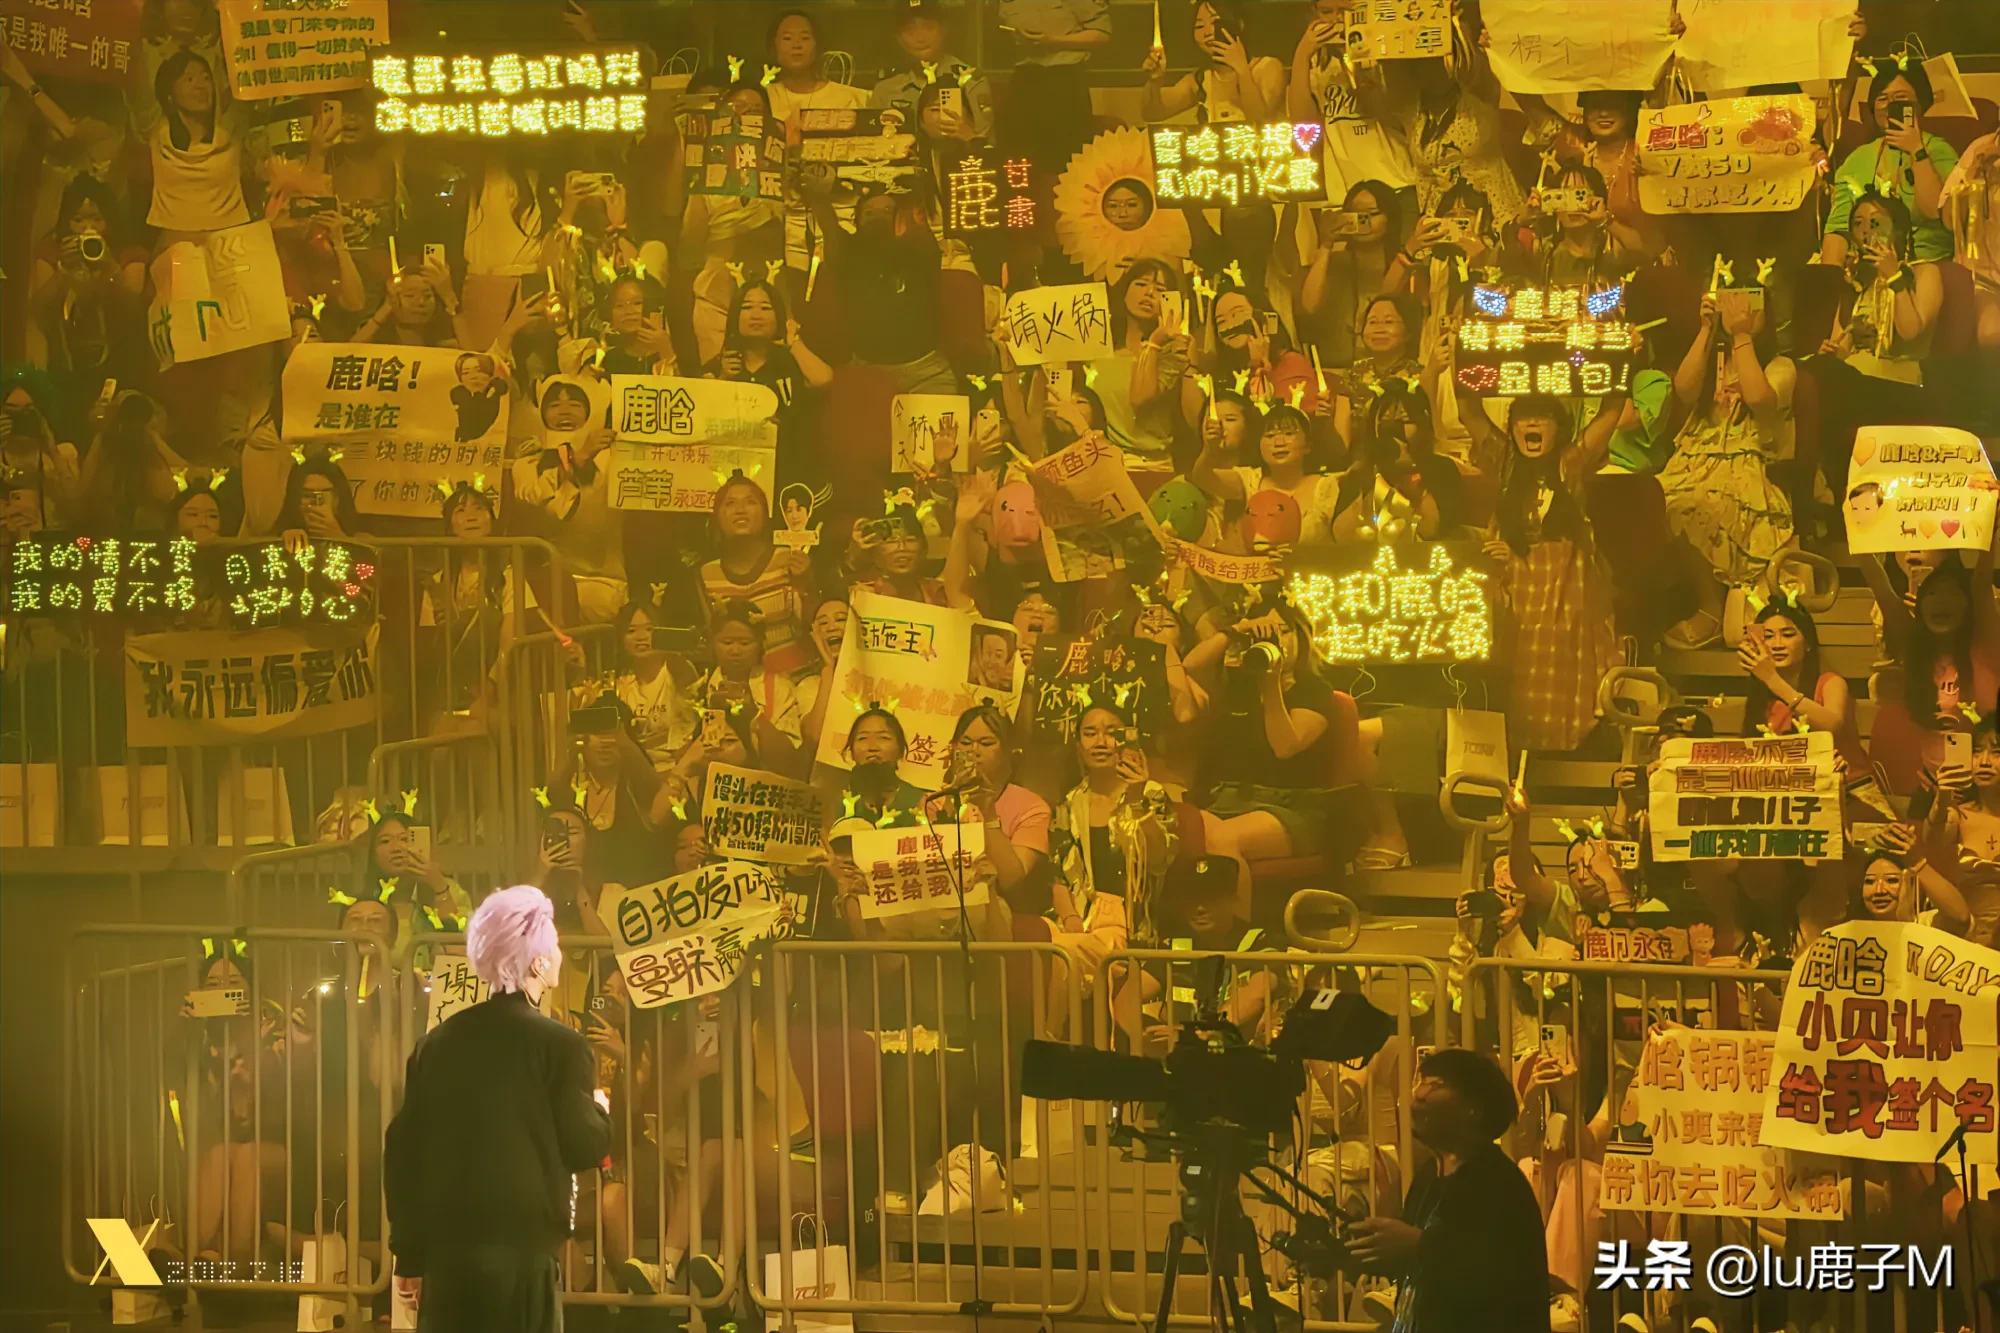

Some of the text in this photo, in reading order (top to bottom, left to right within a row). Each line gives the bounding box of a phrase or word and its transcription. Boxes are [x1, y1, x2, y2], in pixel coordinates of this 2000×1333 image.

[1006, 293, 1108, 355] 请火锅
[325, 354, 422, 392] 鹿晗！
[313, 402, 401, 430] 是谁在
[621, 384, 696, 436] 鹿晗
[11, 536, 197, 575] 我的情不变
[11, 574, 197, 613] 我的爱不移
[138, 640, 375, 720] 我永远偏爱你
[873, 873, 952, 907] 还给我
[1799, 932, 1888, 996] 鹿晗
[1796, 991, 1964, 1062] 小贝让你
[1776, 1058, 1995, 1140] 给我签个名
[1603, 1156, 1842, 1214] 带你去吃火锅
